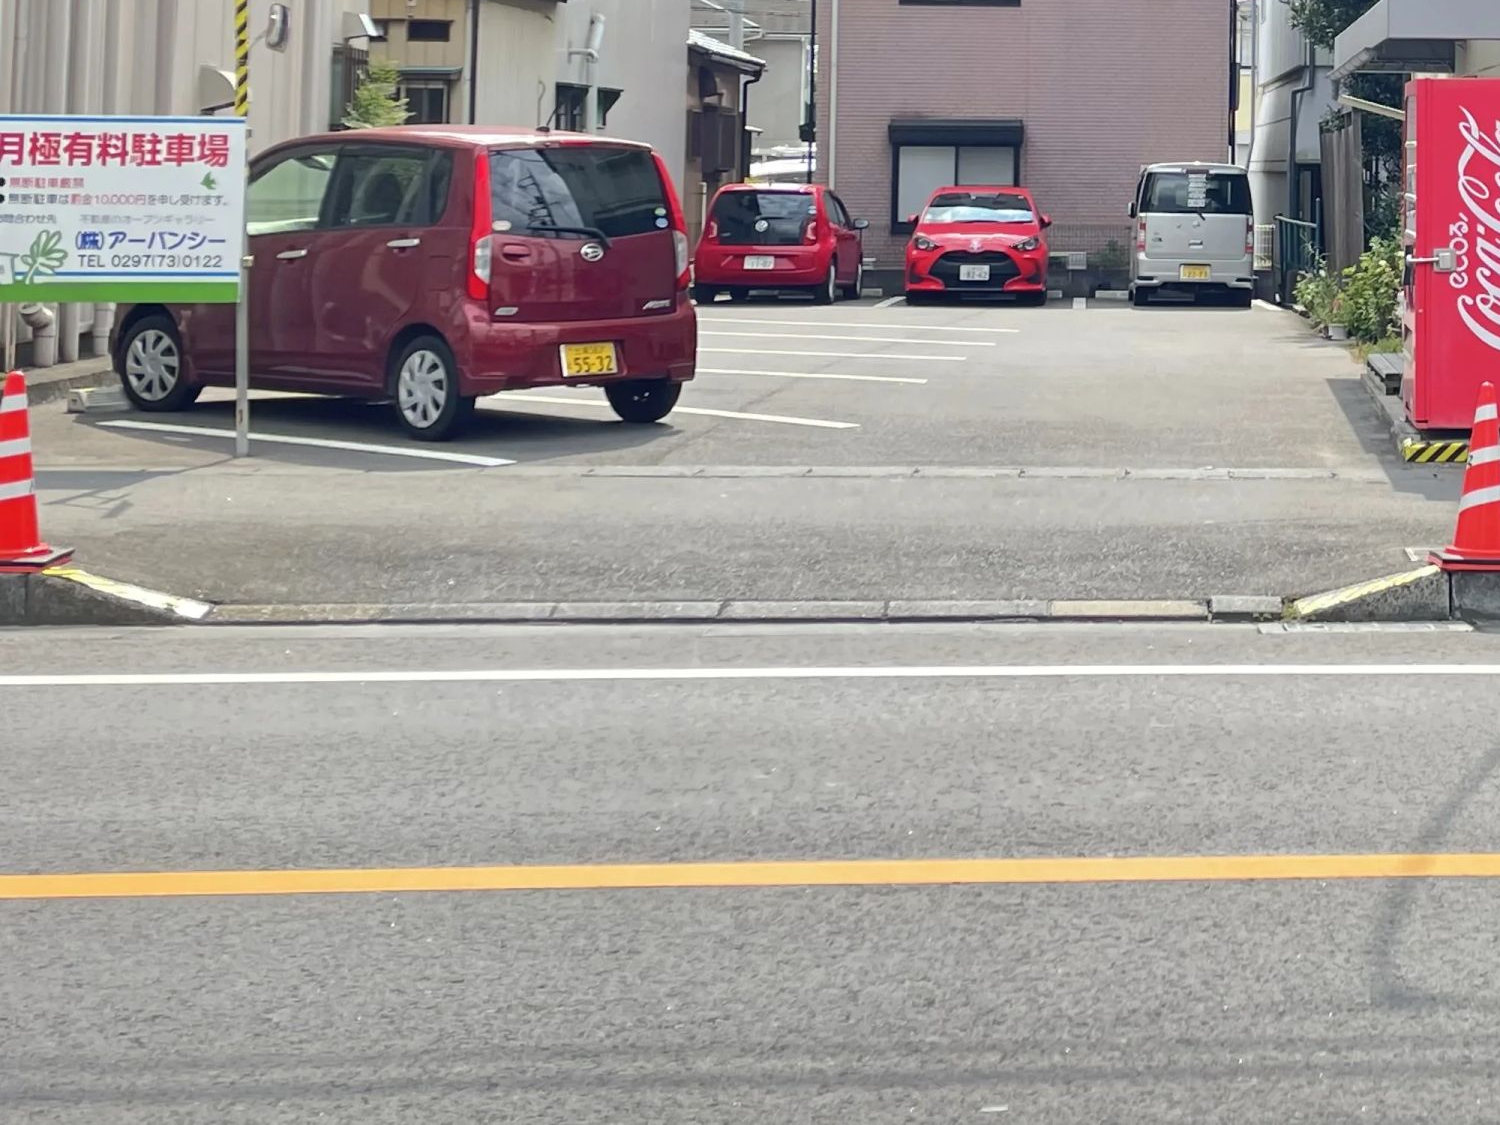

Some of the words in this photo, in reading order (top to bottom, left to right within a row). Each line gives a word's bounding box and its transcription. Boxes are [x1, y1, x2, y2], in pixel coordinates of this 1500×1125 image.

[0, 132, 229, 167] 月極有料駐車場
[78, 254, 106, 268] TEL
[111, 254, 223, 268] 0297(73)0122
[574, 355, 614, 373] 55-32
